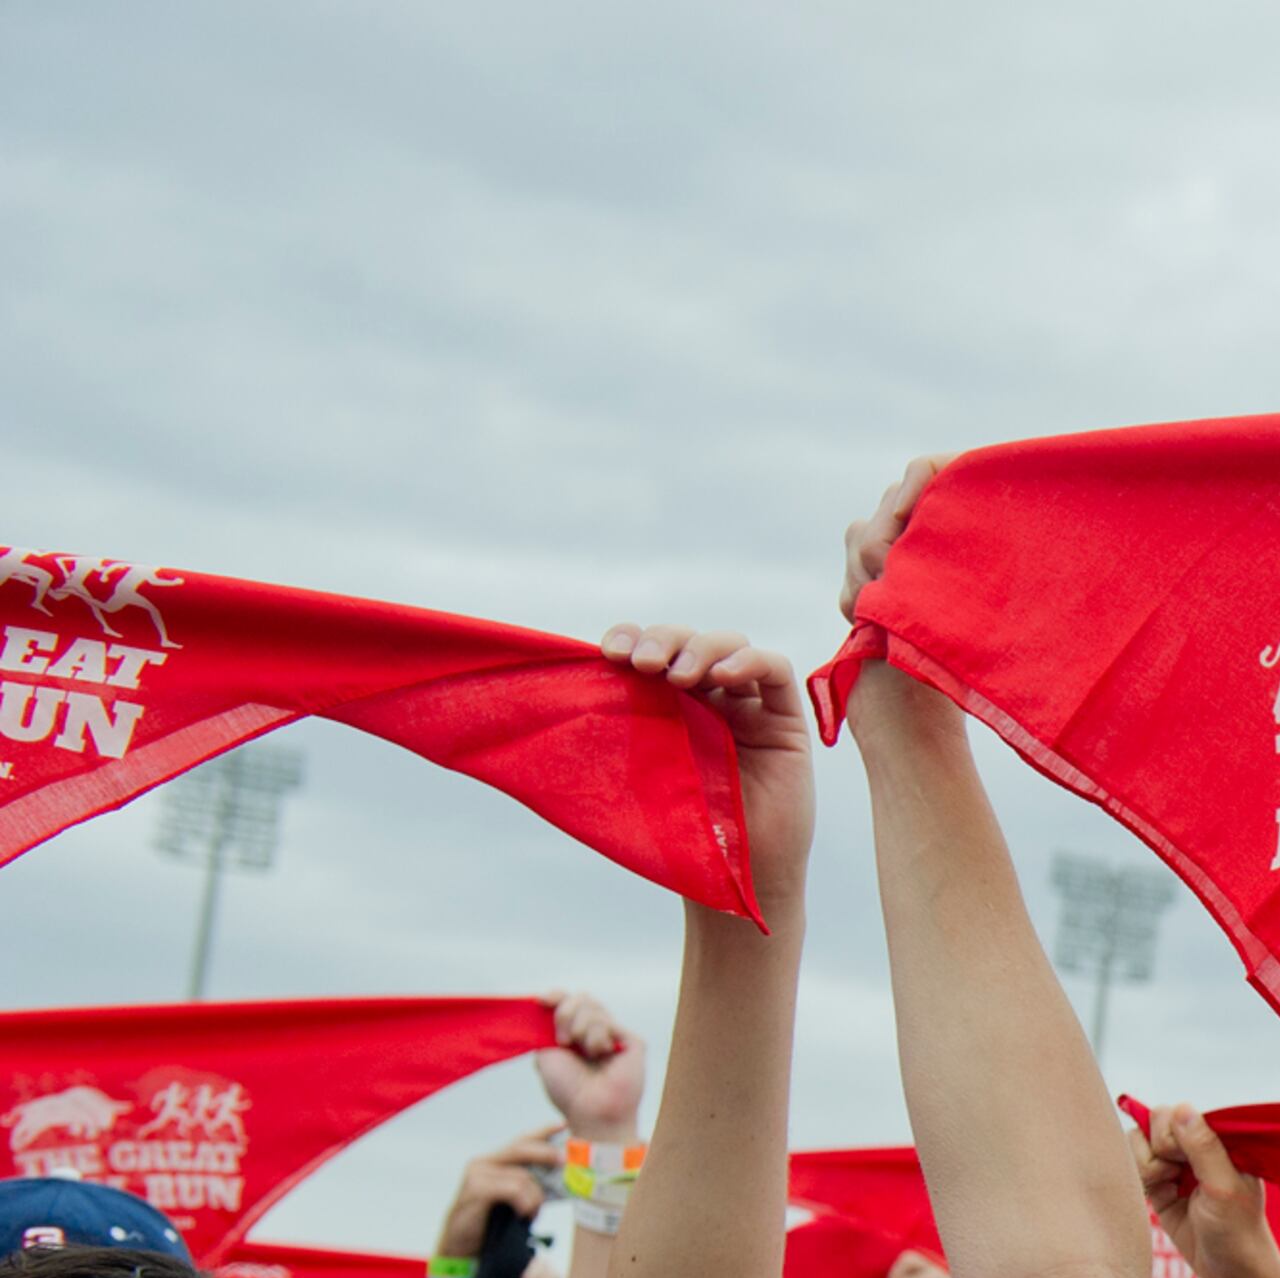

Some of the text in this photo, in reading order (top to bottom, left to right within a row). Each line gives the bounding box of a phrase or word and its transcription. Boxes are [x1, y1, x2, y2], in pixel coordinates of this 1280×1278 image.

[0, 625, 169, 690] EAT
[0, 680, 145, 760] UN
[15, 1140, 247, 1178] THE GREAT
[145, 1173, 245, 1213] RUN
